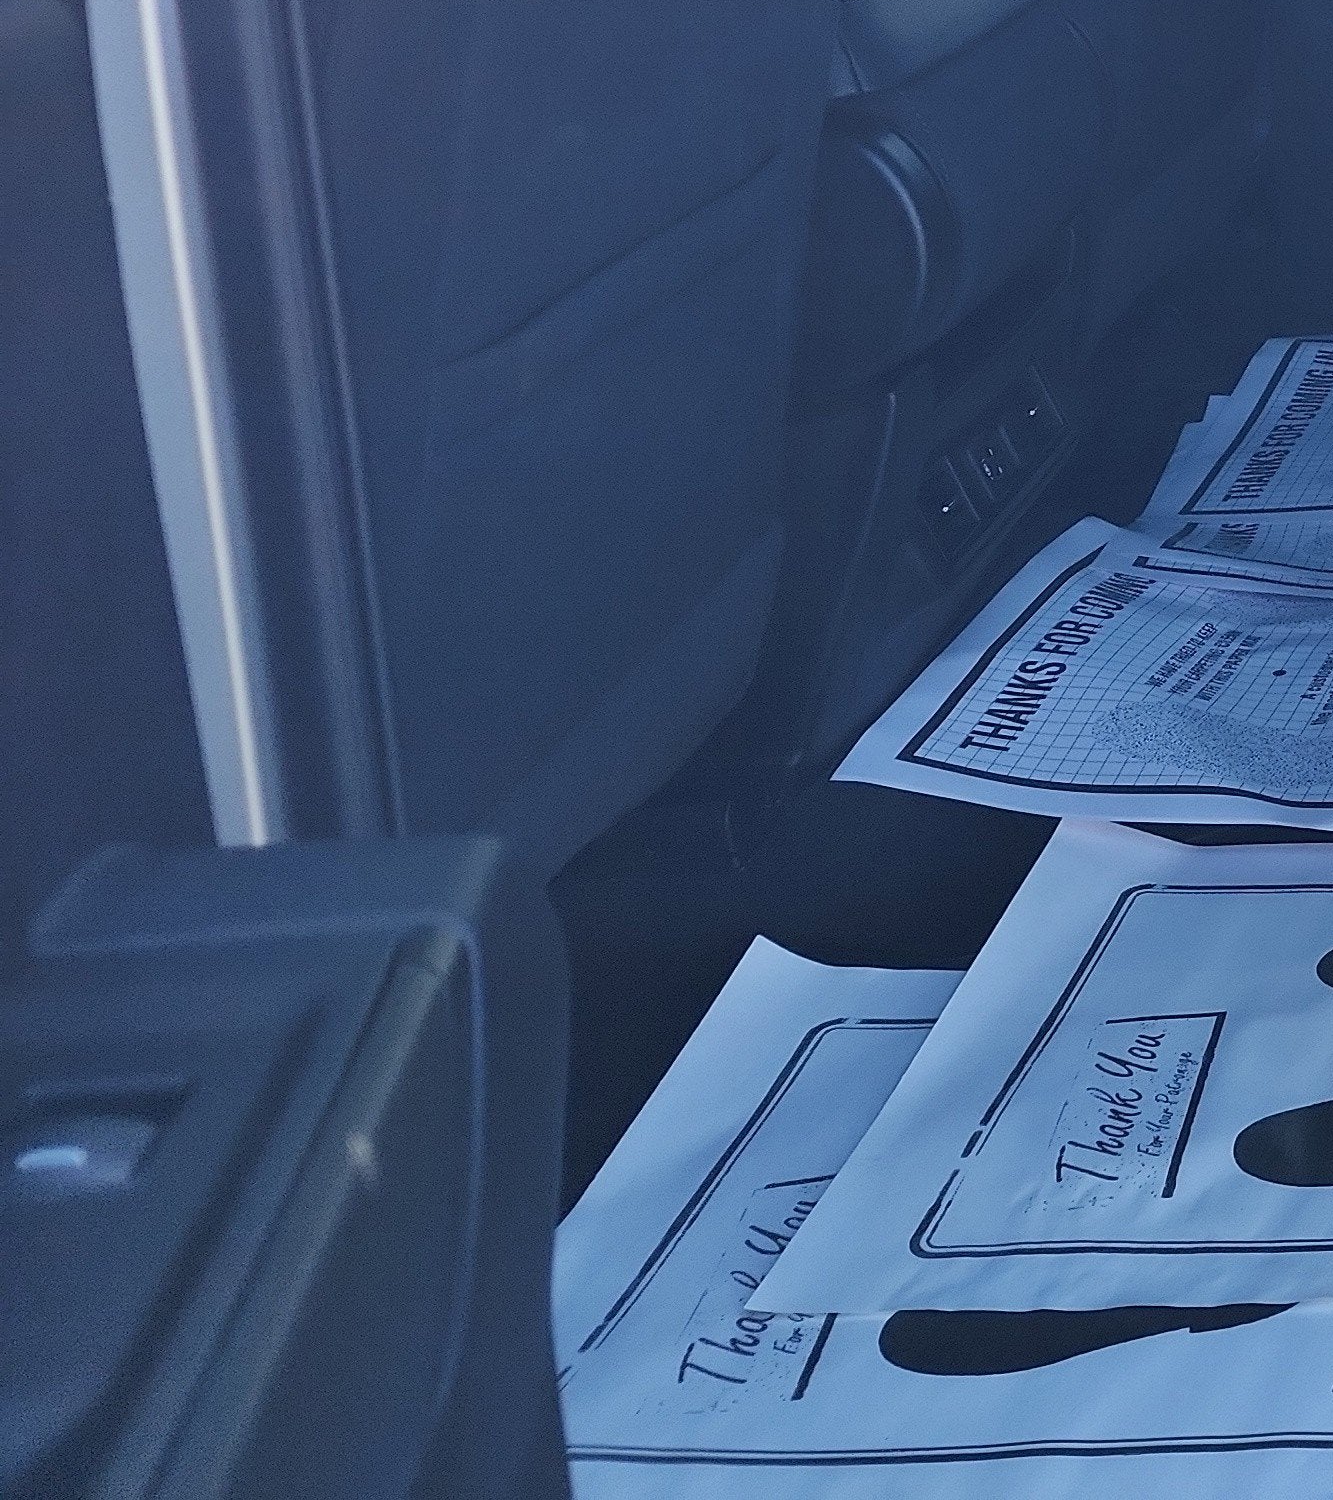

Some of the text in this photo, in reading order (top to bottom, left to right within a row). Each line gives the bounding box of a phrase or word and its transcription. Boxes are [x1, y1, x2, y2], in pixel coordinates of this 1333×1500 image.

[1221, 450, 1291, 501] THANKS
[1261, 422, 1310, 448] FOR
[1195, 622, 1218, 640] KEEP
[959, 660, 1067, 752] THANKS
[1032, 619, 1104, 657] FOR
[1056, 1032, 1166, 1183] Thank You
[1137, 1051, 1200, 1158] For Your Patronage
[772, 1326, 804, 1355] For
